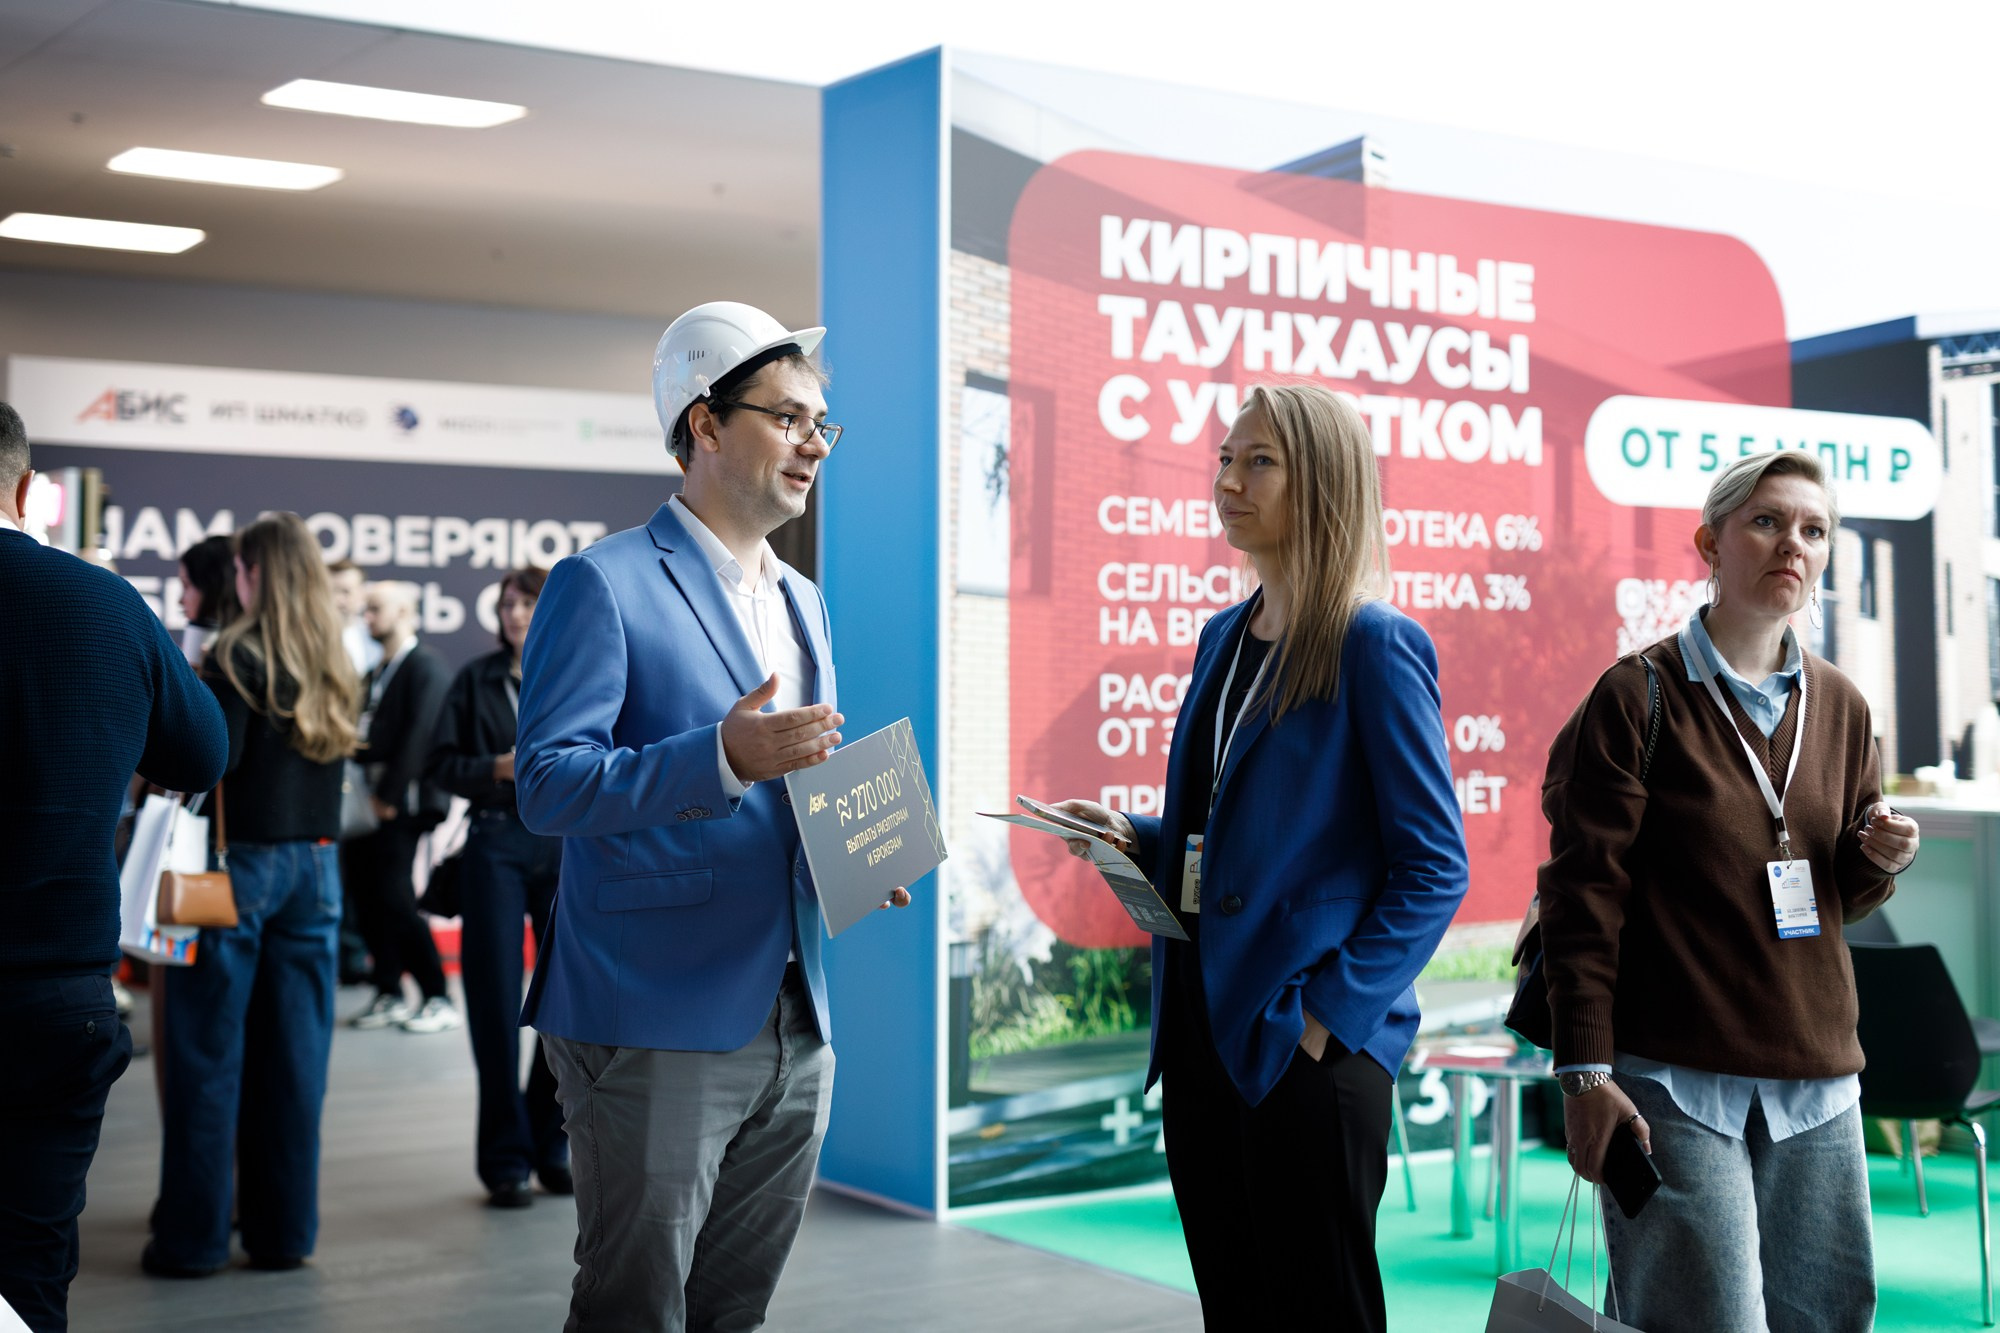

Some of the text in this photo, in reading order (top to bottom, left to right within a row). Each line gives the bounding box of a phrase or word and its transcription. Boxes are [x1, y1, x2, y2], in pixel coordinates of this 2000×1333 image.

[1100, 214, 1536, 323] КИРПИЧНЫЕ
[1098, 294, 1530, 393] ТАУНХАУСЫ
[1098, 374, 1543, 466] С УЧТКОМ
[1621, 427, 1681, 469] ОТ
[257, 510, 608, 570] ОВЕРЯЮТ
[1494, 513, 1543, 552] 6%
[1483, 573, 1532, 611] 3%
[1100, 606, 1160, 646] НА
[1097, 717, 1155, 758] ОТ
[1454, 714, 1506, 753] 0%
[851, 781, 877, 820] 270
[876, 768, 901, 805] 000
[846, 825, 878, 854] ВЫПЛАТЫ
[867, 835, 903, 867] И БРОКЕРАМ
[1783, 927, 1815, 936] УЧАСТНИК
